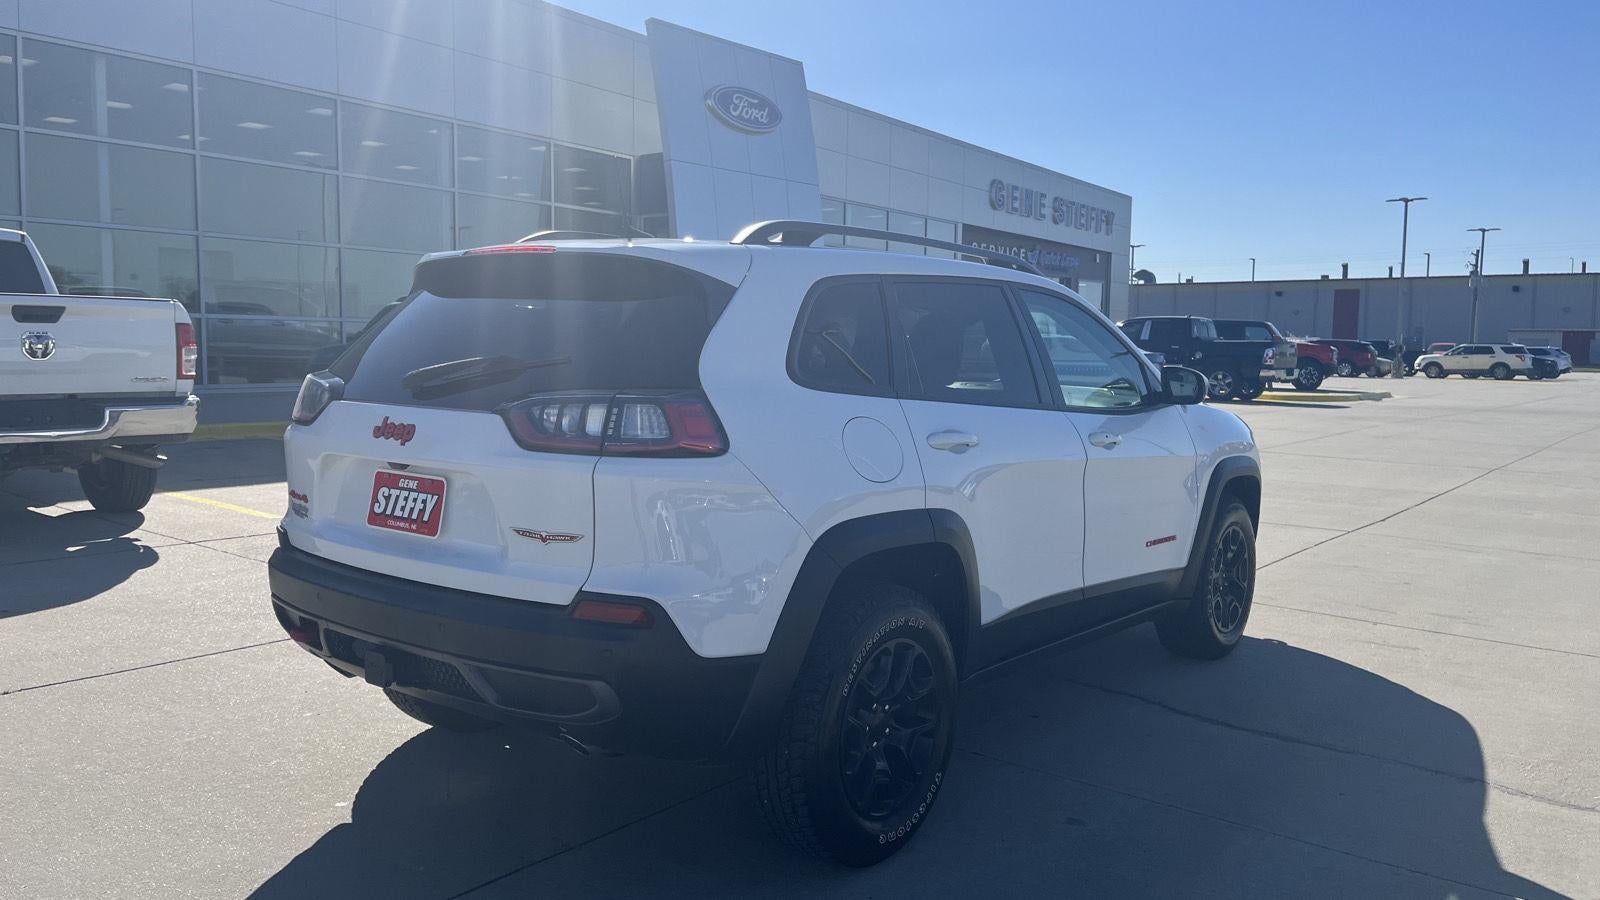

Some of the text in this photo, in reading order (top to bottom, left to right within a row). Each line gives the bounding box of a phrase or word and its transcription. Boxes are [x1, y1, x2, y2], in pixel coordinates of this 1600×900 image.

[730, 93, 769, 123] Ford
[989, 178, 1115, 236] GENE STEFFY
[373, 416, 416, 446] Jeep
[398, 478, 419, 489] GENE
[373, 486, 439, 522] STEFFY
